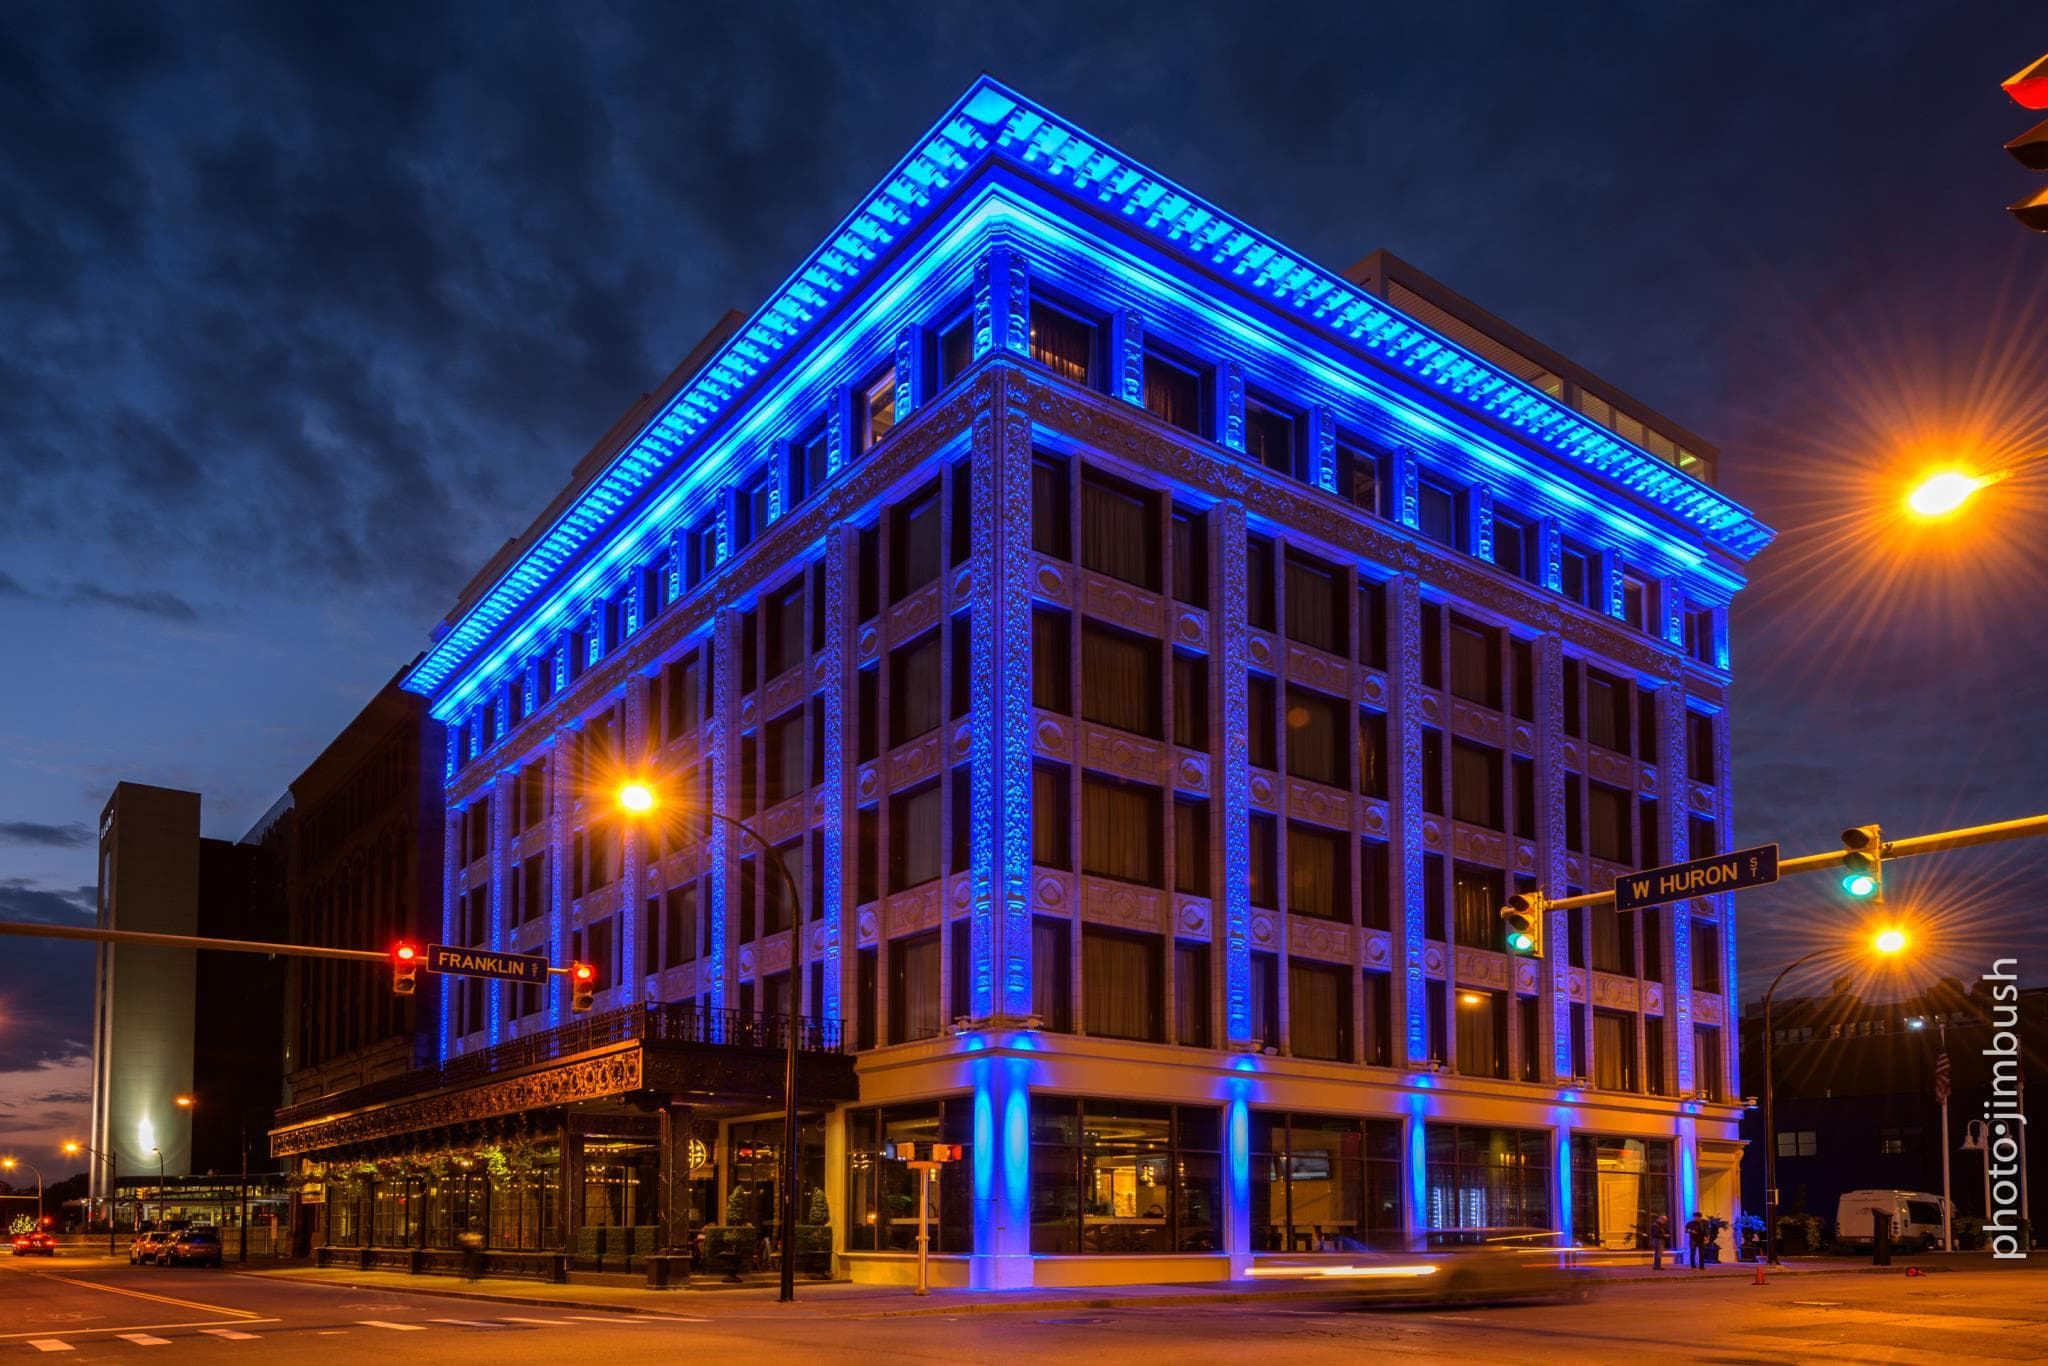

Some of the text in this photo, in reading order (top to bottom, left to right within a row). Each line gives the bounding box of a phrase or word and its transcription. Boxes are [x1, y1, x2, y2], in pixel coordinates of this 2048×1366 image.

[1632, 857, 1758, 899] W HURON ST
[438, 952, 524, 976] FRANKLIN
